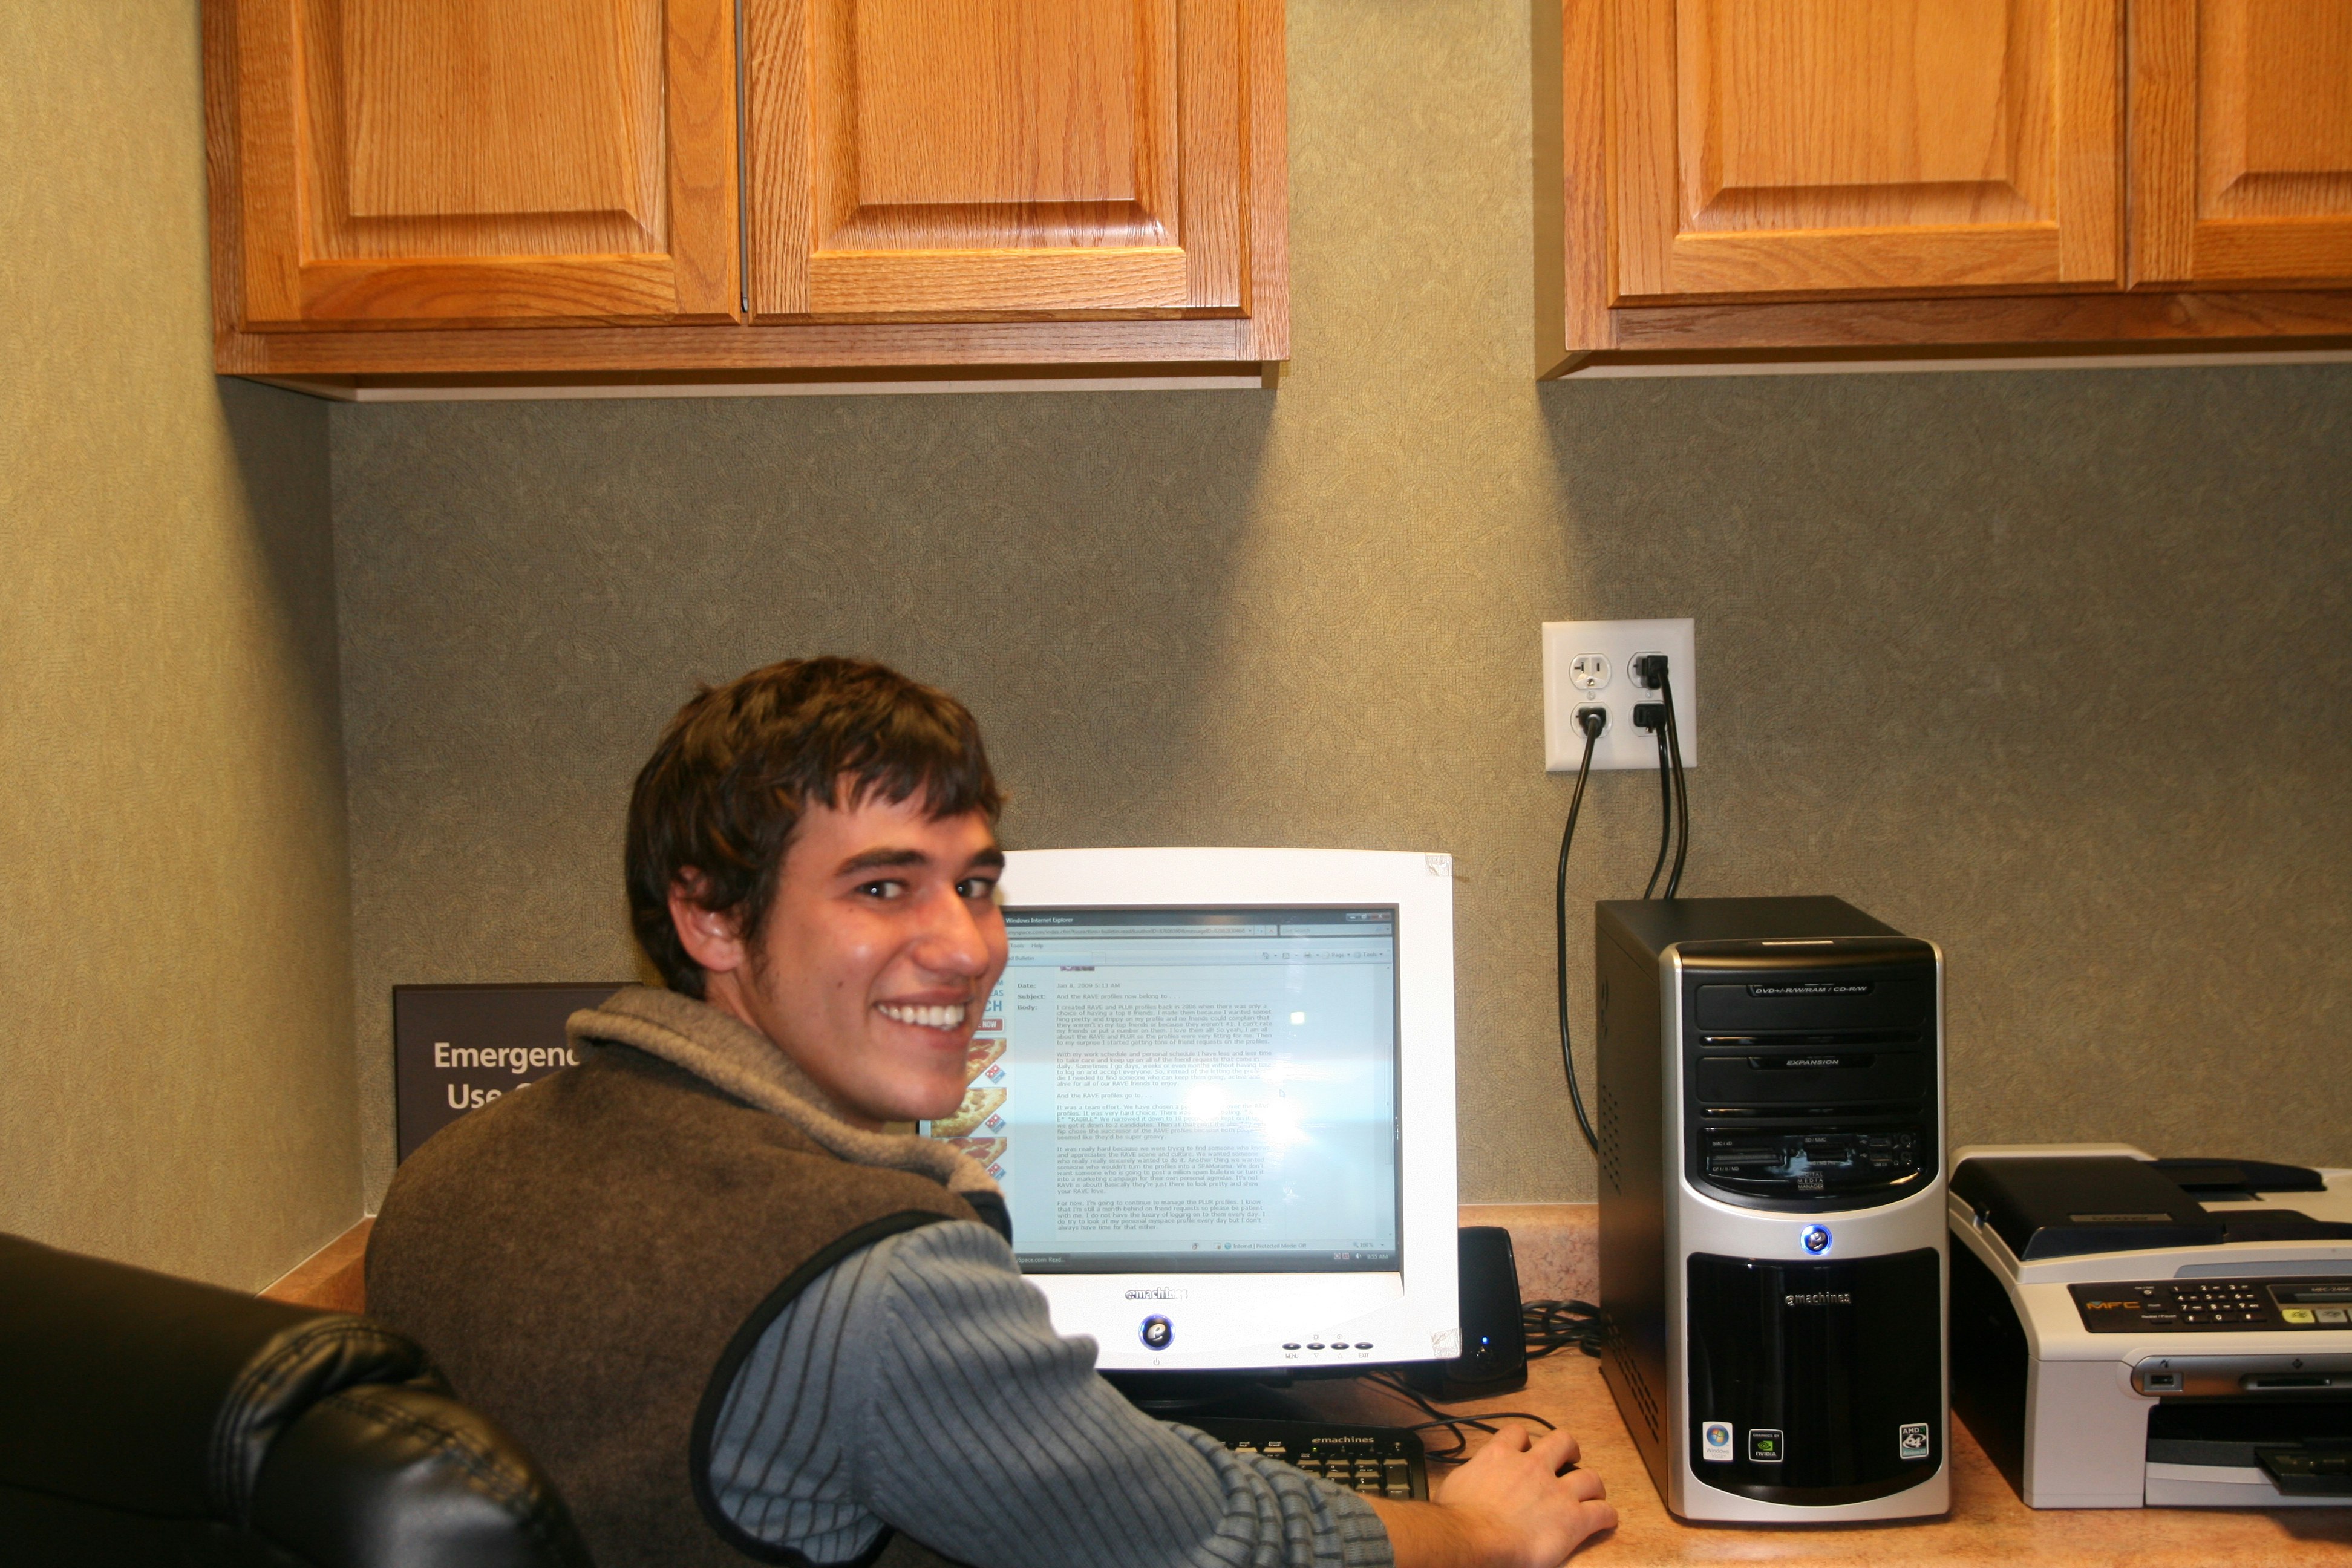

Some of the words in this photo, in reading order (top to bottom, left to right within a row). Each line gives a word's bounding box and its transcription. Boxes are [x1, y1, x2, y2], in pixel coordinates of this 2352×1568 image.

[1785, 1292, 1851, 1306] emachines
[2086, 1301, 2141, 1310] MFC
[1147, 1324, 1166, 1341] e
